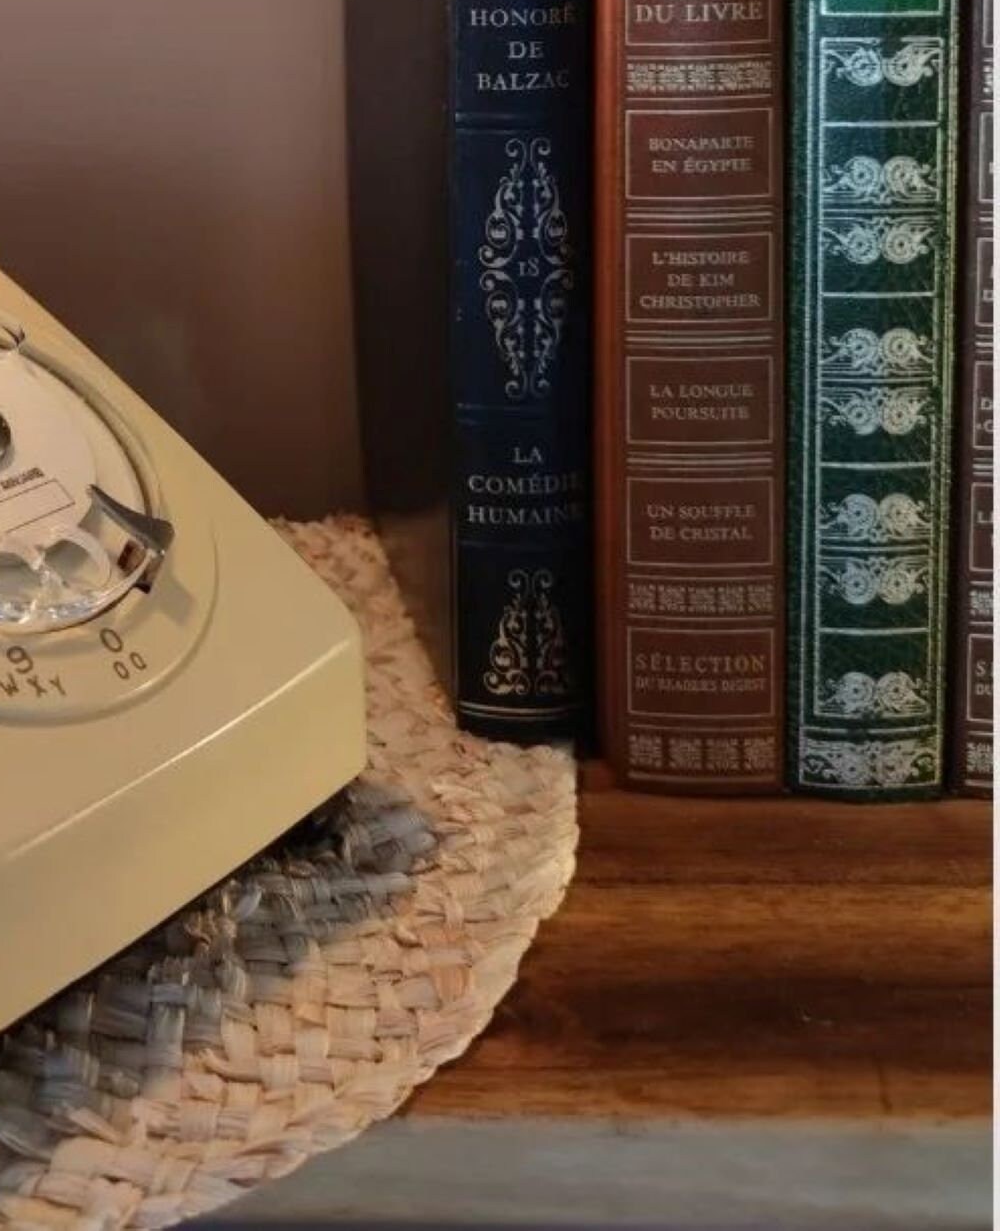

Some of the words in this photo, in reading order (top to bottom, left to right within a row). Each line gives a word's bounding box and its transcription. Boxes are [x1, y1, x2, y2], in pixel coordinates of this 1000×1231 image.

[470, 2, 576, 27] HONORÉ
[636, 4, 674, 23] DU
[685, 1, 763, 22] LIVRE
[508, 41, 544, 59] DE
[477, 69, 570, 91] BALZAC
[649, 136, 754, 151] BONAPARTE
[652, 159, 677, 173] EN
[668, 273, 691, 287] DE
[700, 272, 735, 287] KIM
[639, 293, 761, 309] CHRISTOPHER
[650, 384, 673, 398] LA
[680, 384, 755, 399] LONGUE
[651, 406, 750, 420] POURSUITE
[512, 446, 543, 464] LA
[647, 505, 674, 518] UN
[680, 505, 756, 519] SOUFFLE
[650, 526, 674, 540] DE
[680, 526, 753, 540] CRISTAL
[6, 645, 34, 675] 9
